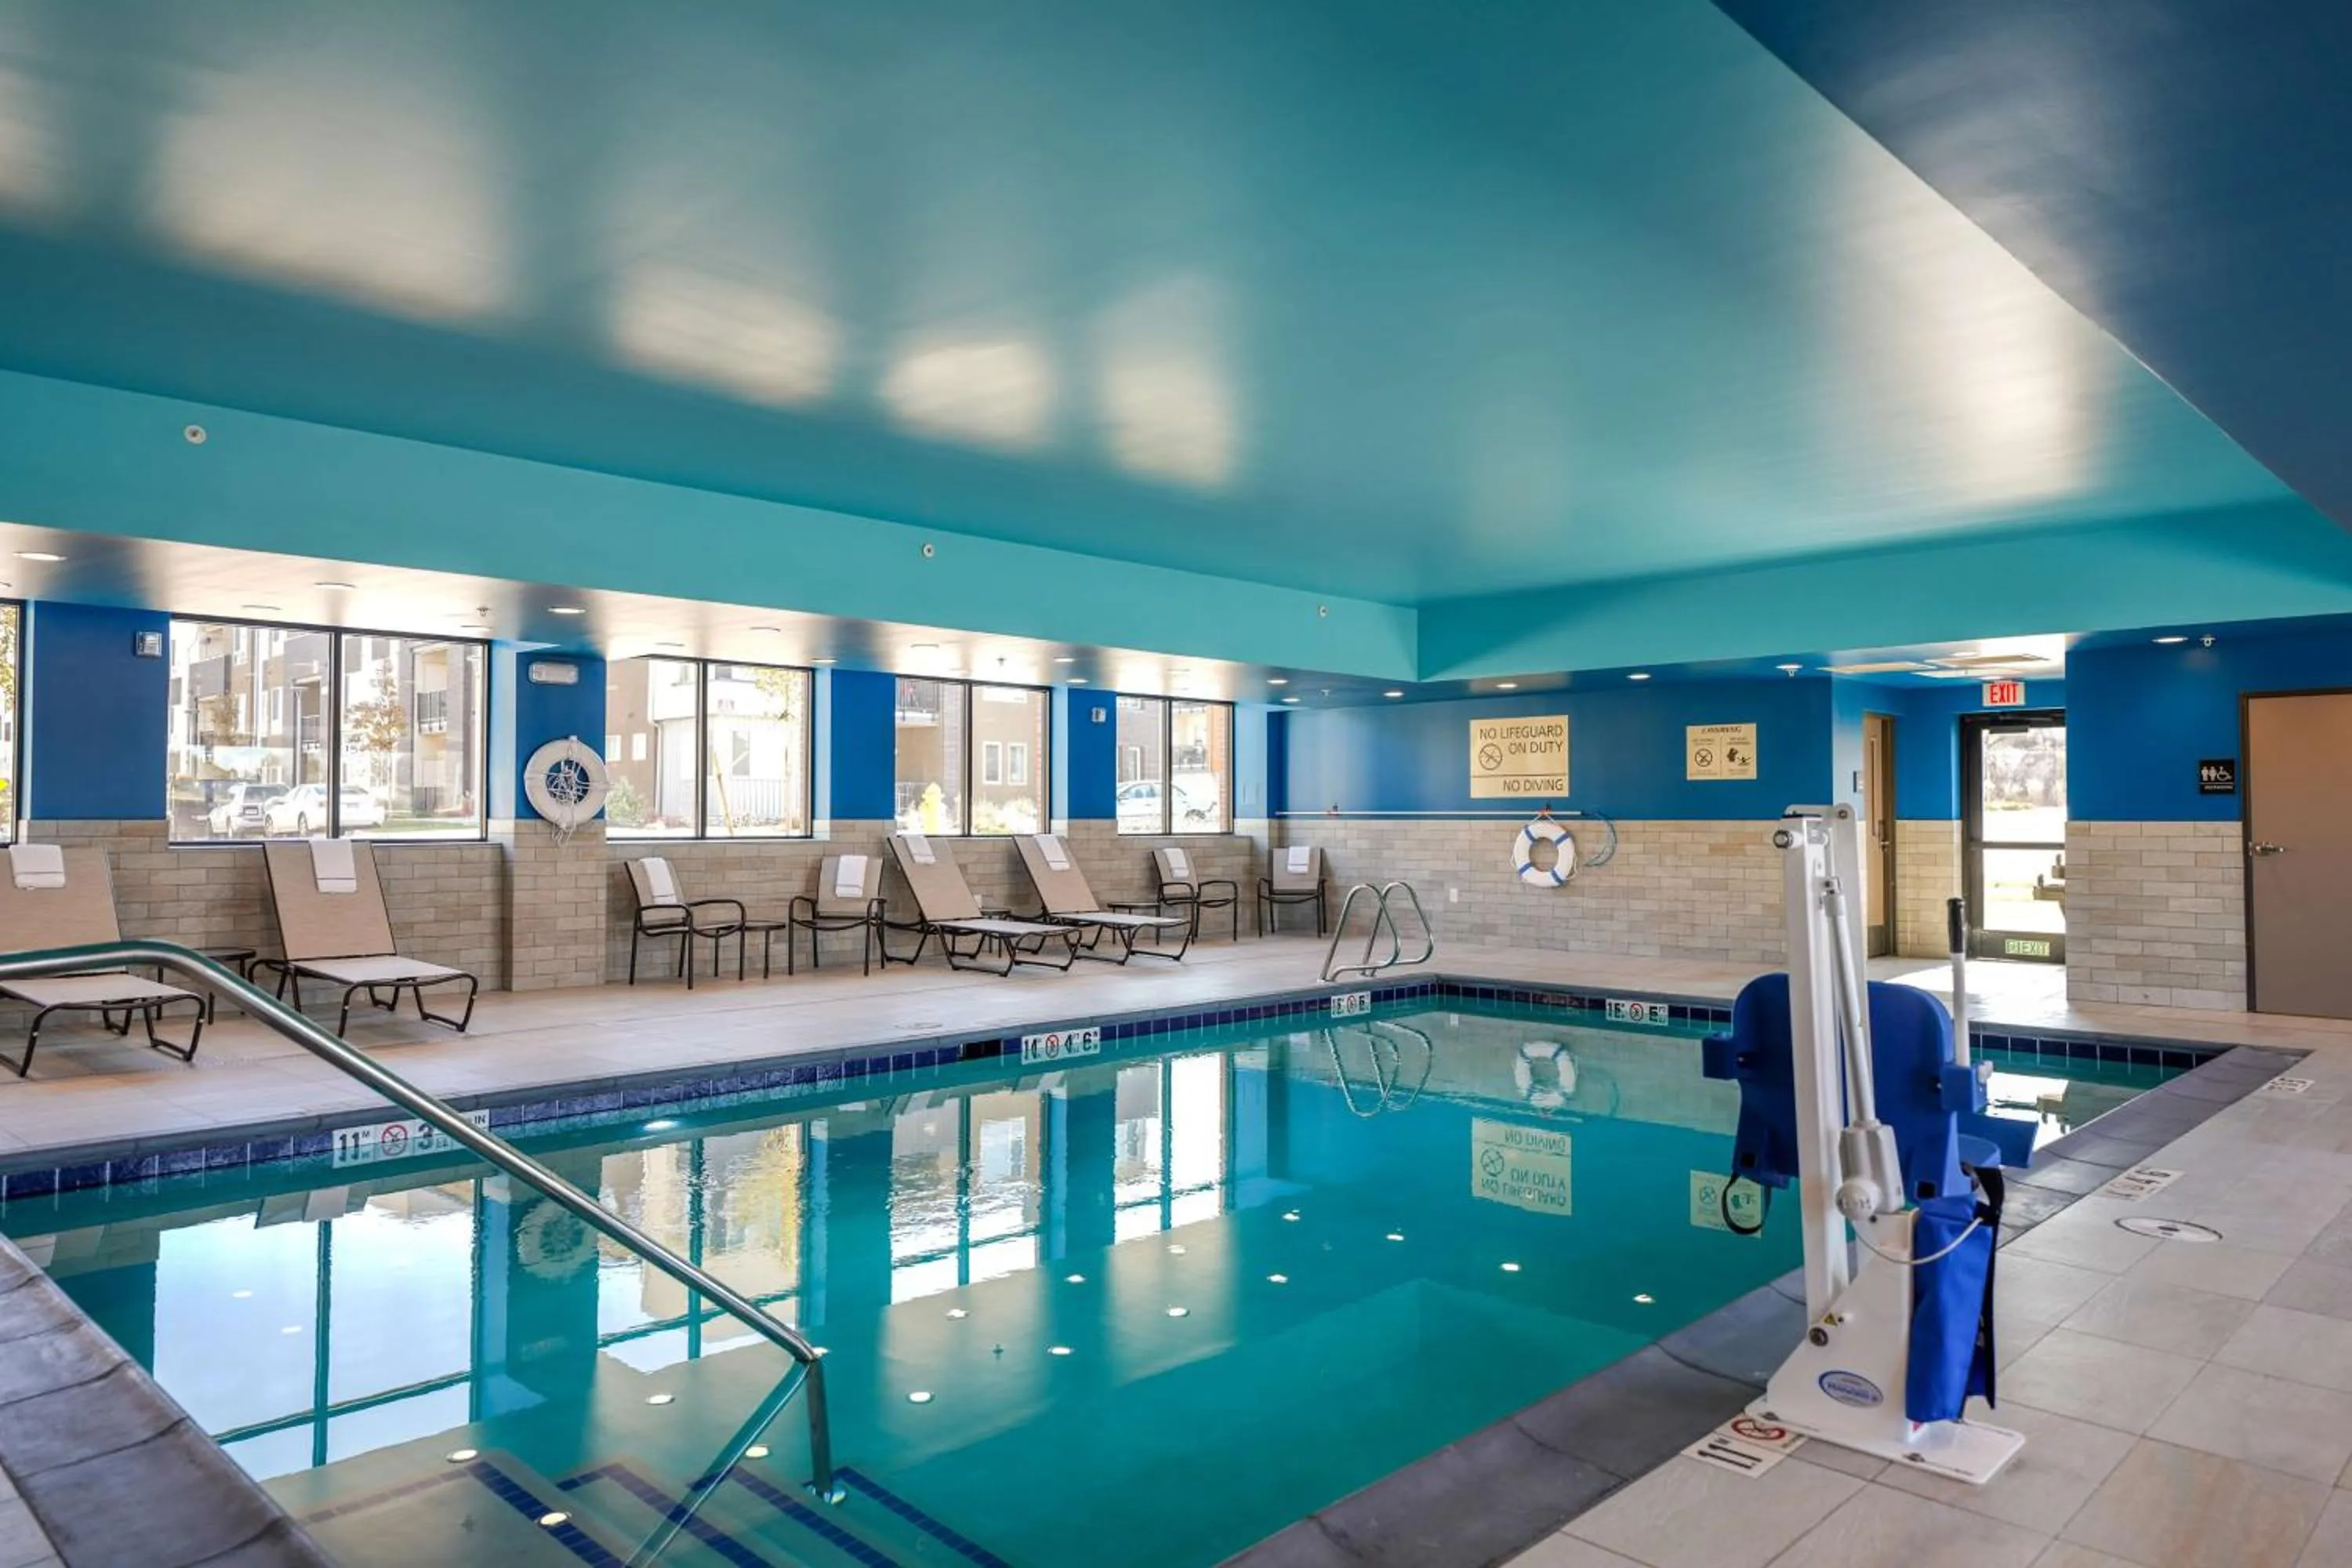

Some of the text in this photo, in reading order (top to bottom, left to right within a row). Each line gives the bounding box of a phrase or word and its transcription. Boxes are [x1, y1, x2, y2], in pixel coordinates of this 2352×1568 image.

[1990, 684, 2018, 702] EXIT
[1479, 725, 1563, 739] NO LIFEGUARD
[1508, 741, 1563, 754] ON DUTY
[1503, 779, 1563, 791] NO DIVING
[2023, 942, 2046, 954] EXIT
[474, 1115, 486, 1124] IN
